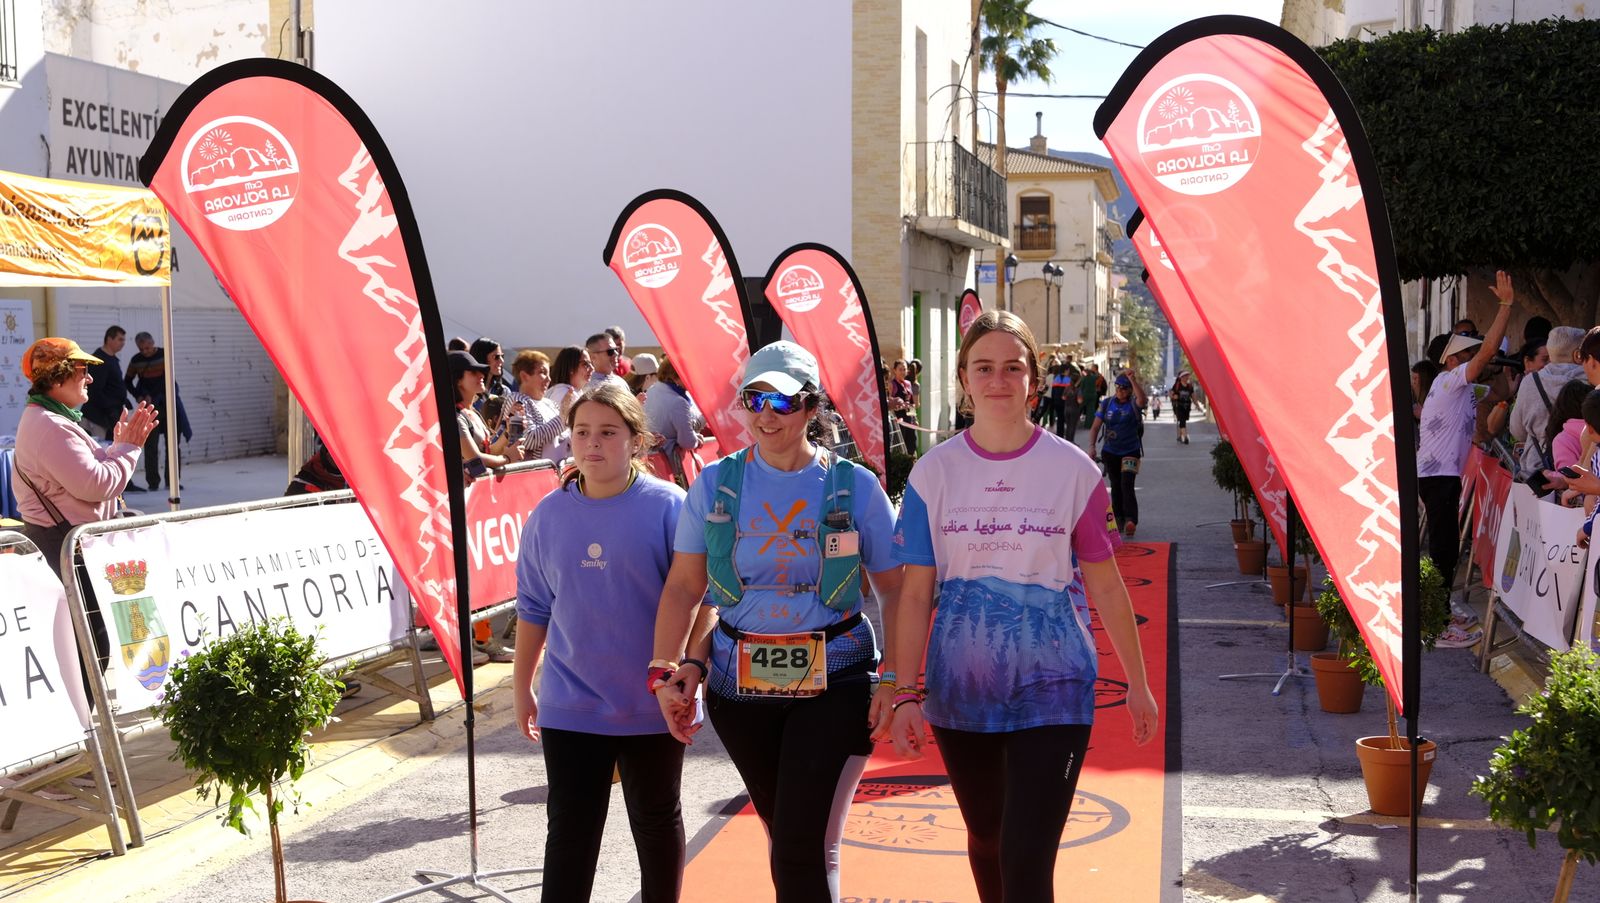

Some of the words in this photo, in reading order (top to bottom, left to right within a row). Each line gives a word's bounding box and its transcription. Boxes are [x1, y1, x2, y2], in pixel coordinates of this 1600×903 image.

[62, 96, 164, 141] EXCELENTÍ
[66, 145, 141, 182] AYUNTA
[176, 543, 347, 590] AYUNTAMIENTO
[355, 537, 381, 558] DE
[968, 541, 1023, 552] PURCHENA
[181, 565, 395, 647] CANTORIA
[752, 647, 809, 669] 428
